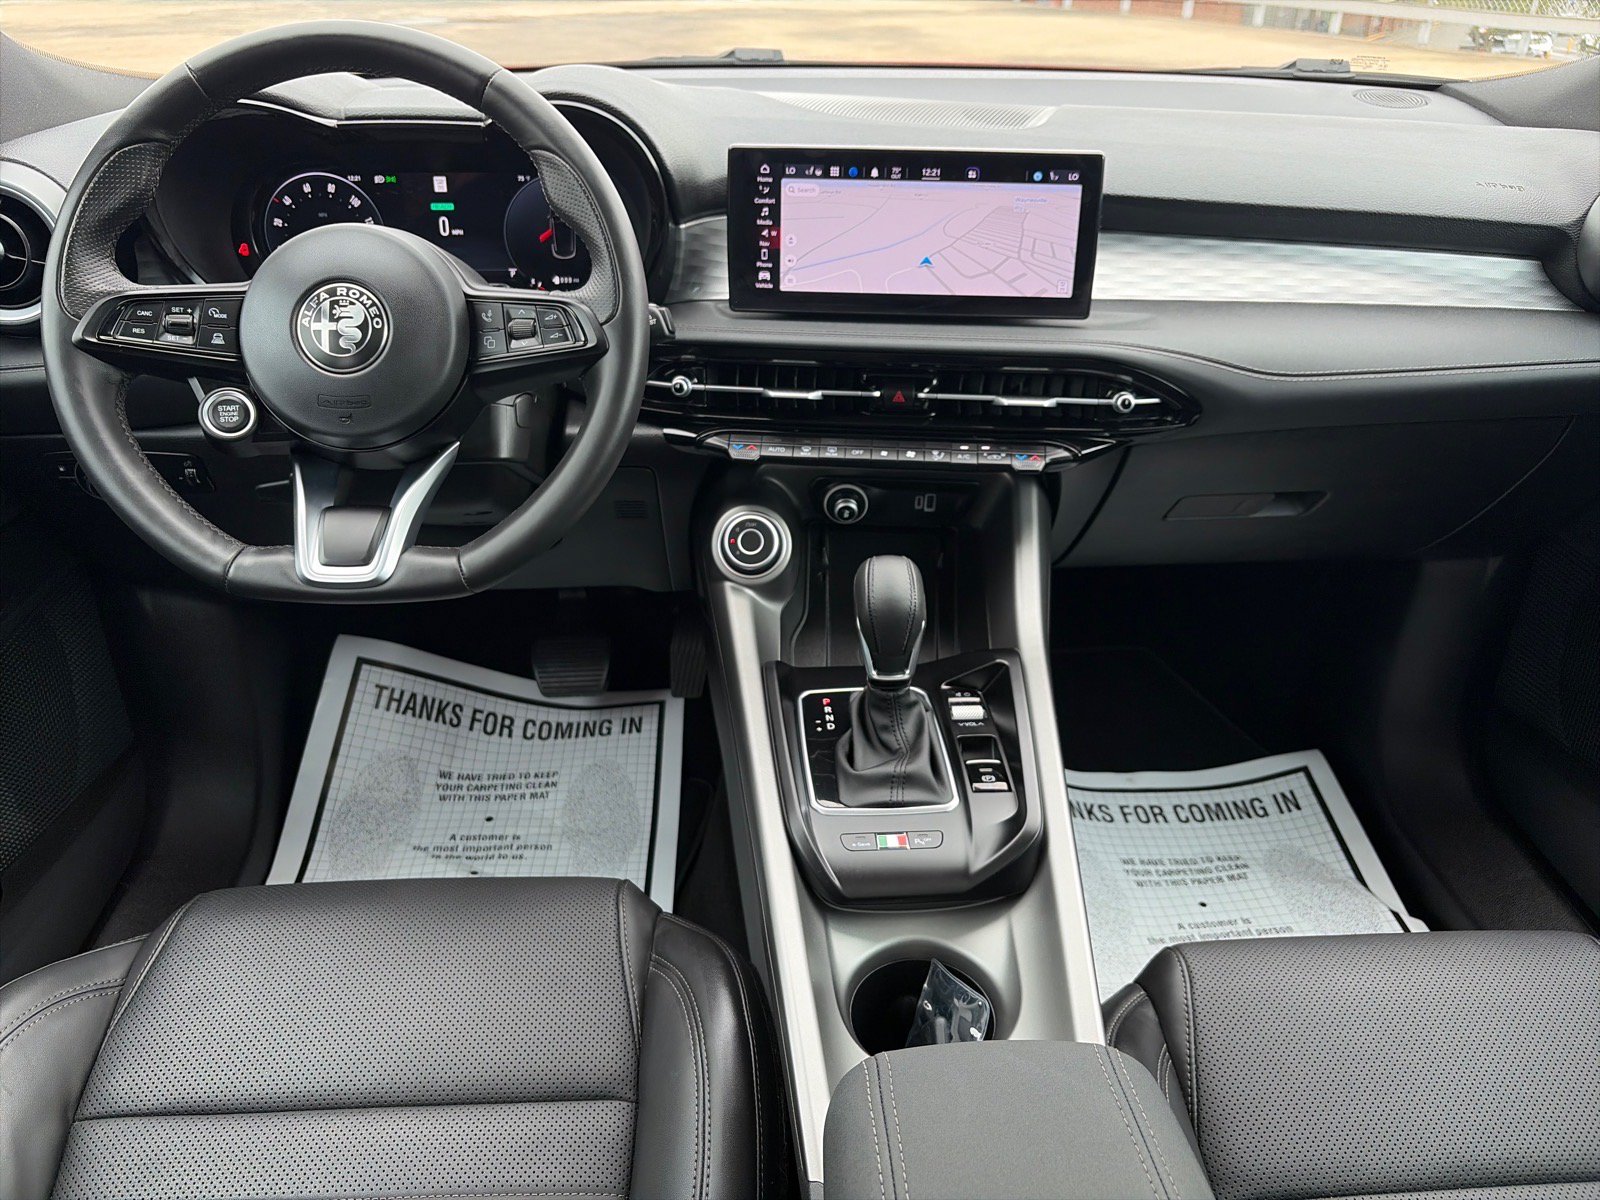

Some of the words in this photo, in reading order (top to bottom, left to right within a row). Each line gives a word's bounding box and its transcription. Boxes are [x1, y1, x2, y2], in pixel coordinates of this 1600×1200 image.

[786, 166, 796, 174] LO
[922, 168, 940, 176] 12:21
[439, 216, 449, 236] 0
[302, 291, 329, 327] ALFA
[337, 287, 383, 329] ROMEO
[374, 683, 464, 729] THANKS
[469, 709, 514, 738] FOR
[522, 719, 613, 741] COMING
[620, 716, 643, 734] IN
[826, 722, 836, 730] D
[439, 770, 454, 781] WE
[457, 772, 483, 781] HAVE
[487, 773, 515, 781] TRIED
[519, 772, 531, 780] TO
[534, 770, 559, 779] KEEP
[435, 781, 463, 792] YOUR
[466, 782, 522, 792] CARPETING
[525, 781, 558, 790] CLEAN
[438, 794, 465, 802] WITH
[469, 794, 491, 802] THIS
[494, 793, 526, 801] PAPER
[529, 791, 550, 800] MAT
[1069, 801, 1115, 823] NKS
[1118, 803, 1169, 824] FOR
[1172, 797, 1270, 824] COMING
[1272, 789, 1302, 815] IN
[450, 833, 456, 841] A
[512, 833, 521, 841] is
[412, 844, 429, 852] the
[432, 844, 459, 852] most
[462, 843, 513, 853] important
[516, 843, 553, 852] person
[465, 853, 495, 861] world
[1120, 857, 1136, 866] WE
[1139, 857, 1166, 866] HAVE
[1168, 857, 1198, 865] TRIED
[1123, 868, 1153, 877] YOUR
[1155, 866, 1213, 877] CARPETING
[1215, 862, 1250, 873] CLEAN
[1134, 879, 1162, 887] WITH
[1164, 878, 1188, 887] THIS
[1190, 875, 1225, 885] PAPER
[1226, 871, 1249, 882] MAT
[1177, 922, 1186, 930] A
[1188, 918, 1238, 930] customer
[1241, 917, 1252, 925] is
[1147, 937, 1165, 945] the
[1169, 934, 1197, 943] most
[1199, 927, 1253, 941] important
[1255, 925, 1295, 937] person
